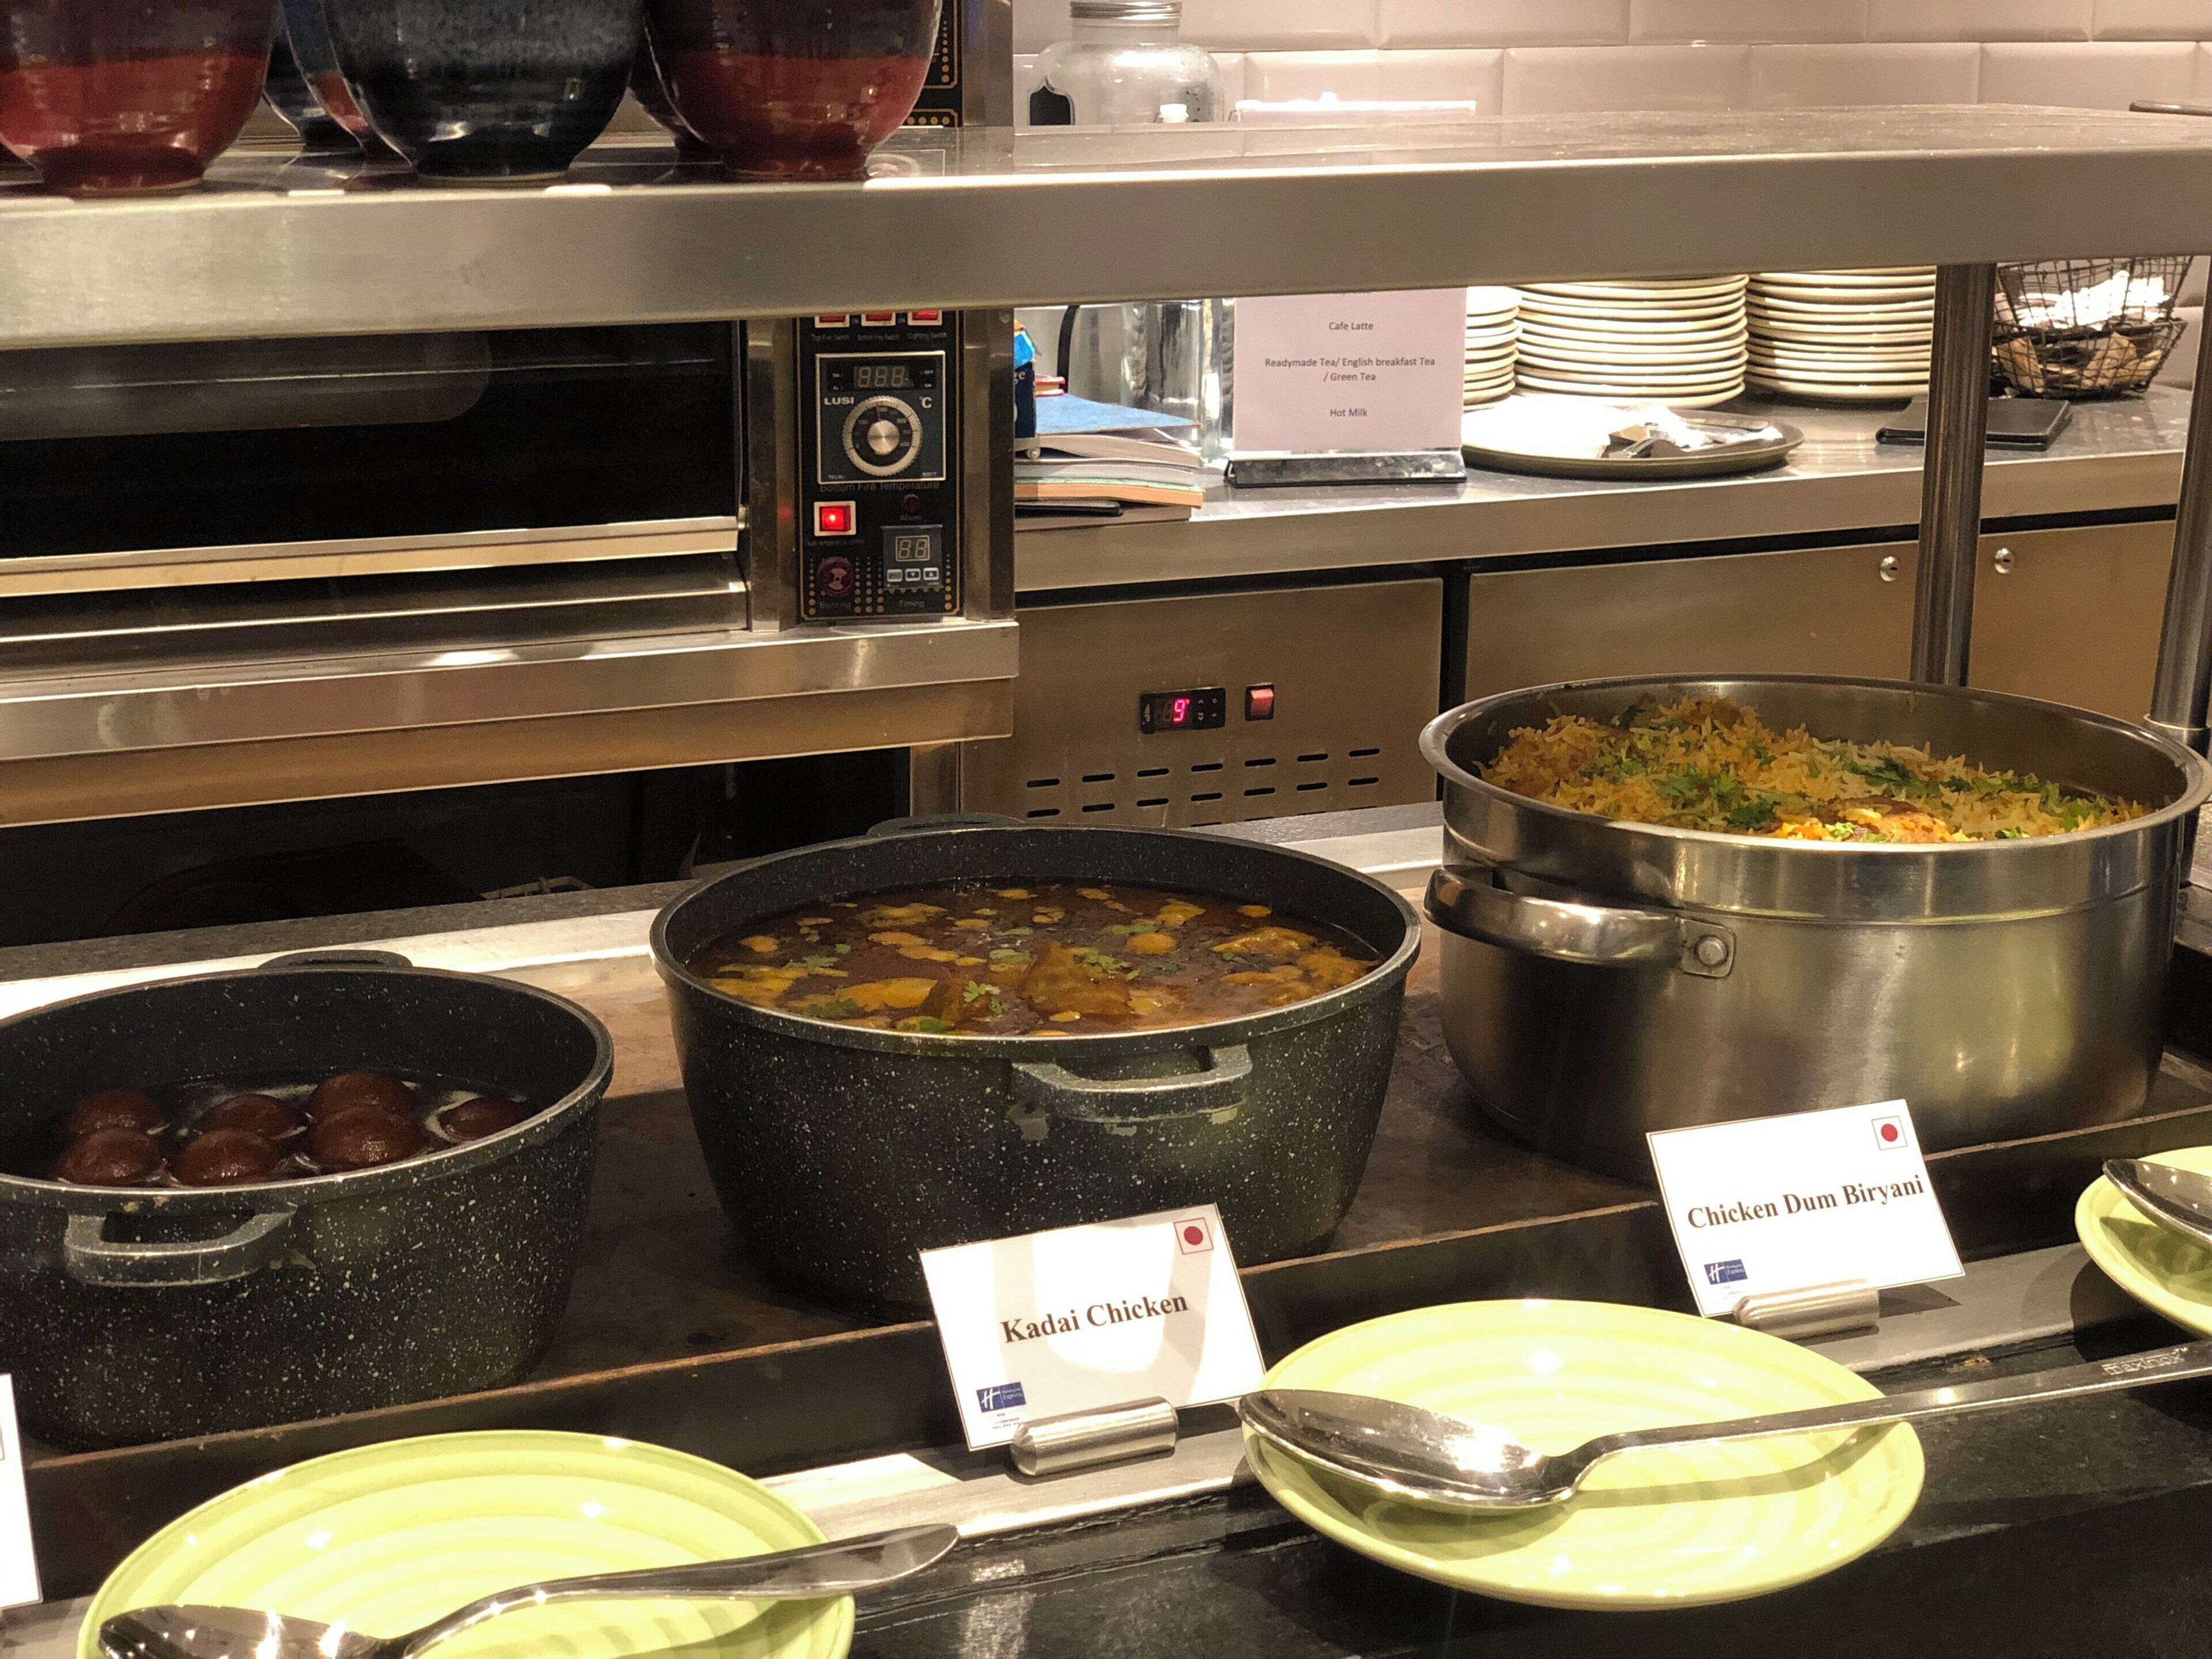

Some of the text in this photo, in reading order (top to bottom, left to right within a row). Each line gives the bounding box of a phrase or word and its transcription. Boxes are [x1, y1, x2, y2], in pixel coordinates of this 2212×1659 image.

[1328, 321, 1374, 331] Cafe Latte
[1265, 357, 1435, 368] Readymade Tea/ English breakfast Tea
[1330, 372, 1358, 381] Green
[1359, 372, 1376, 381] Tea
[824, 396, 855, 406] LUSI
[1330, 408, 1368, 417] Hot Milk
[858, 483, 876, 491] Fire
[880, 481, 940, 492] Temperature
[1687, 1174, 1925, 1228] Chicken Dum Biryani
[1001, 1295, 1190, 1343] Kadai Chicken
